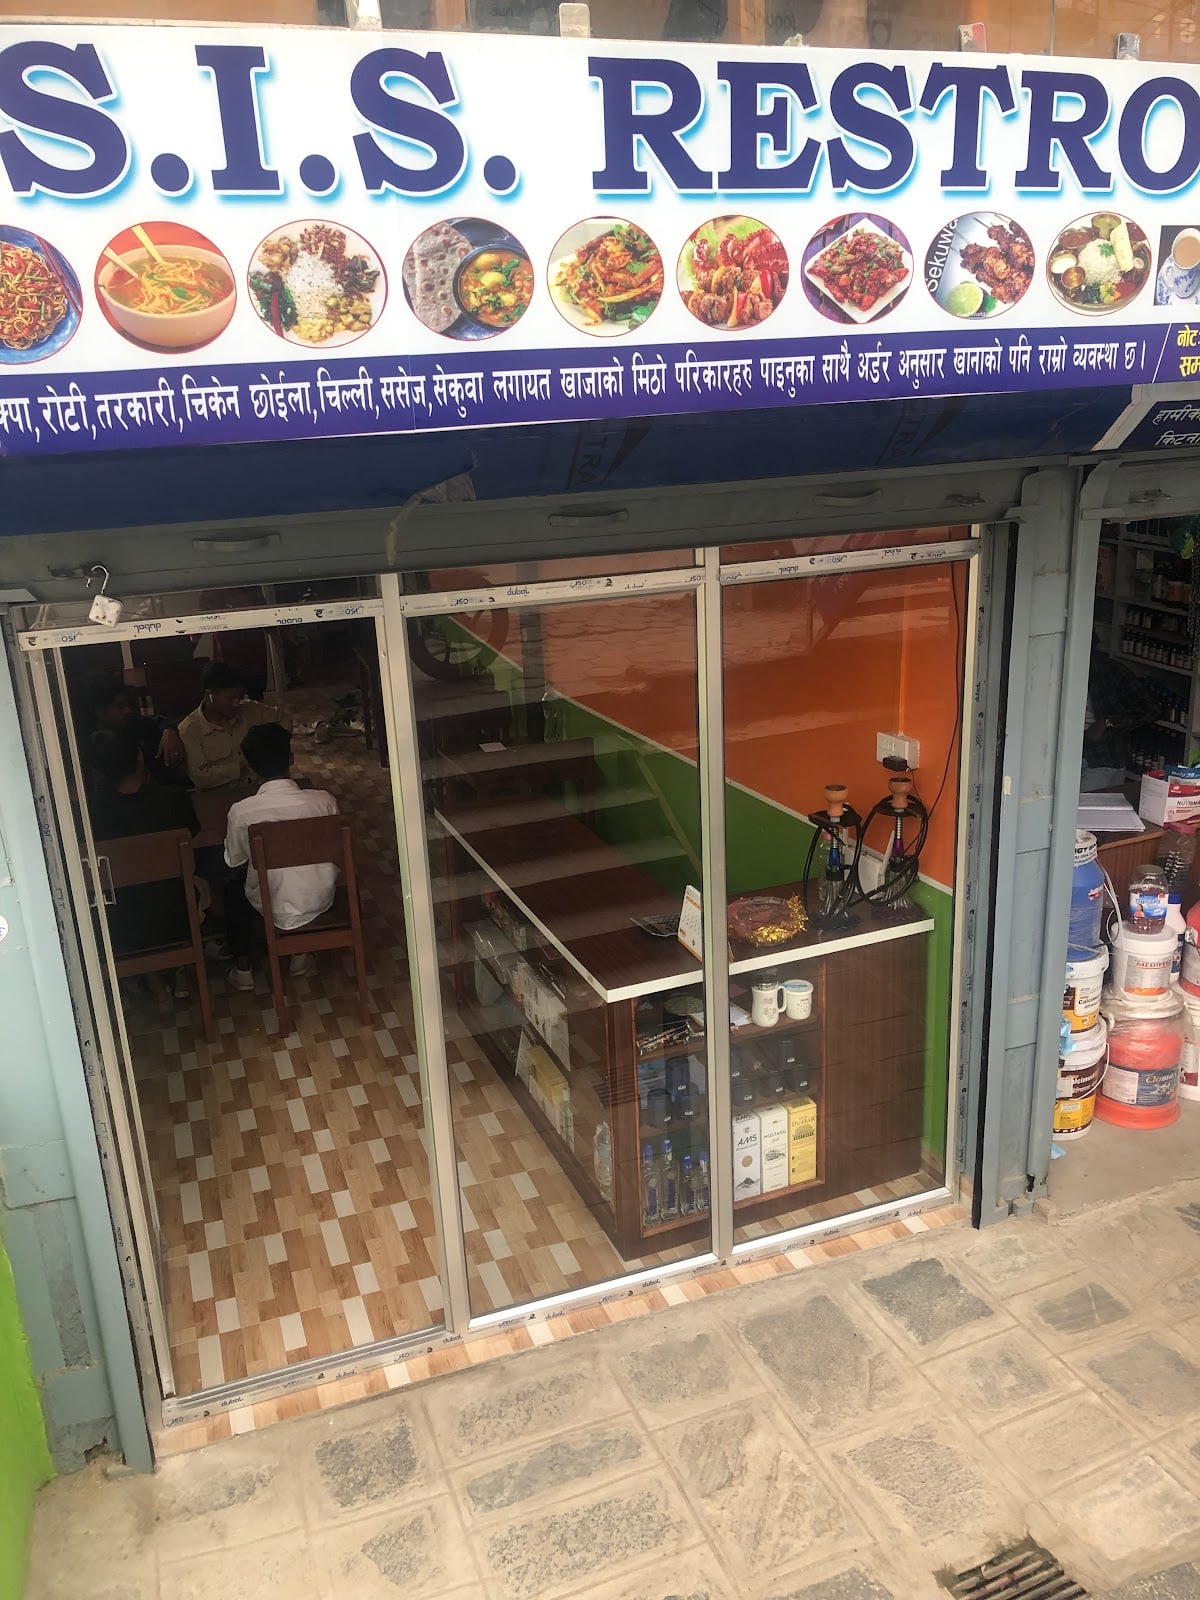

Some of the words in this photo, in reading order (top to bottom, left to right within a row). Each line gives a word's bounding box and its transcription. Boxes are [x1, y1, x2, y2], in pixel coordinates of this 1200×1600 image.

[588, 55, 1200, 195] RESTRO
[491, 368, 552, 402] लगायत
[559, 356, 624, 399] खाजाको
[631, 351, 667, 397] मिठो
[822, 339, 852, 385] साथै
[857, 341, 893, 384] अर्डर
[898, 348, 947, 389] अनुसार
[953, 337, 1002, 376] खानाको
[1008, 334, 1033, 373] पनि
[1038, 336, 1067, 374] राम्रो
[1073, 341, 1120, 371] व्यवस्था
